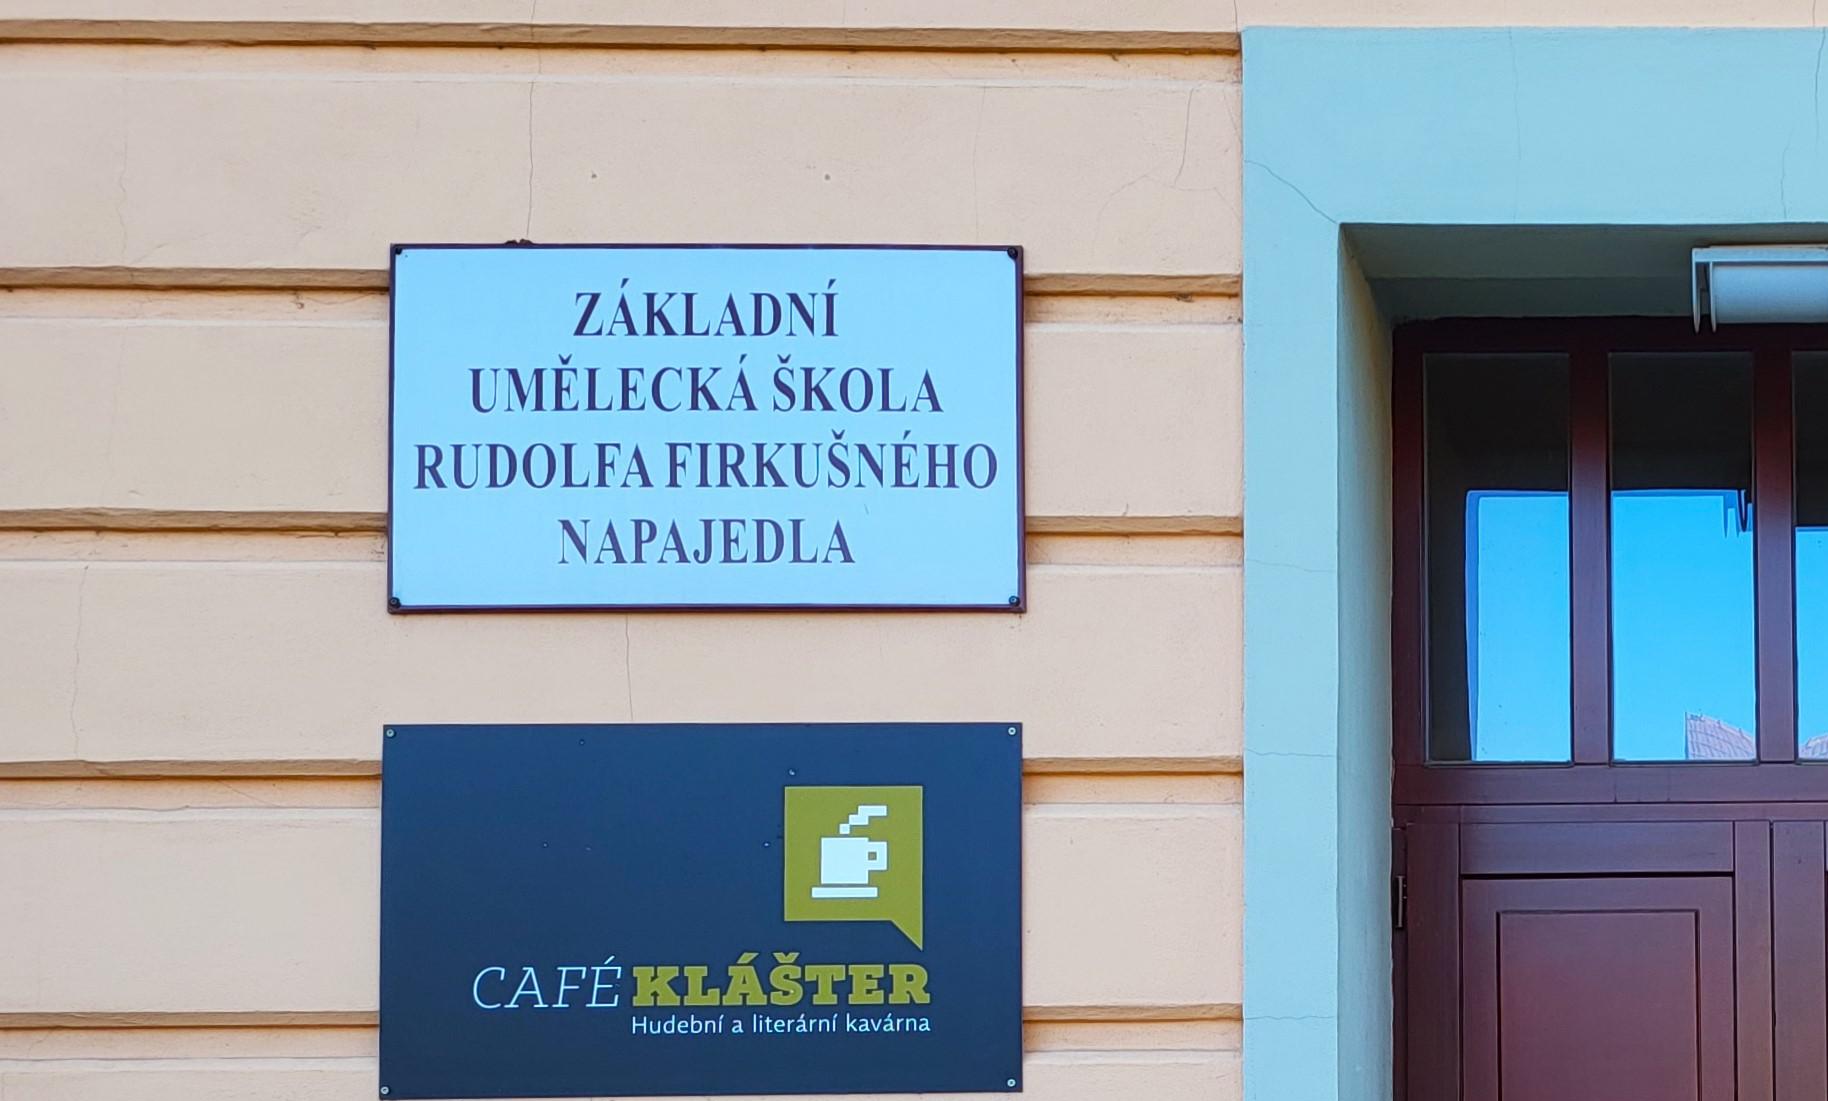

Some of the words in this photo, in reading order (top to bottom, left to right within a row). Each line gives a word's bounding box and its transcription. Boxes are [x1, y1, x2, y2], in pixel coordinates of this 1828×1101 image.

[573, 277, 839, 337] ZÁKLADNÍ
[468, 354, 759, 413] UMĚLECKÁ
[772, 353, 944, 413] ŠKOLA
[413, 442, 654, 490] RUDOLFA
[664, 428, 998, 489] FIRKUŠNÉHO
[557, 518, 856, 565] NAPAJEDLA
[473, 955, 622, 1009] CAFÉ
[632, 952, 931, 1007] KLÁŠTER
[632, 1013, 724, 1034] Hudební
[731, 1019, 744, 1034] a
[752, 1013, 838, 1034] literární
[846, 1013, 931, 1033] kavárna
